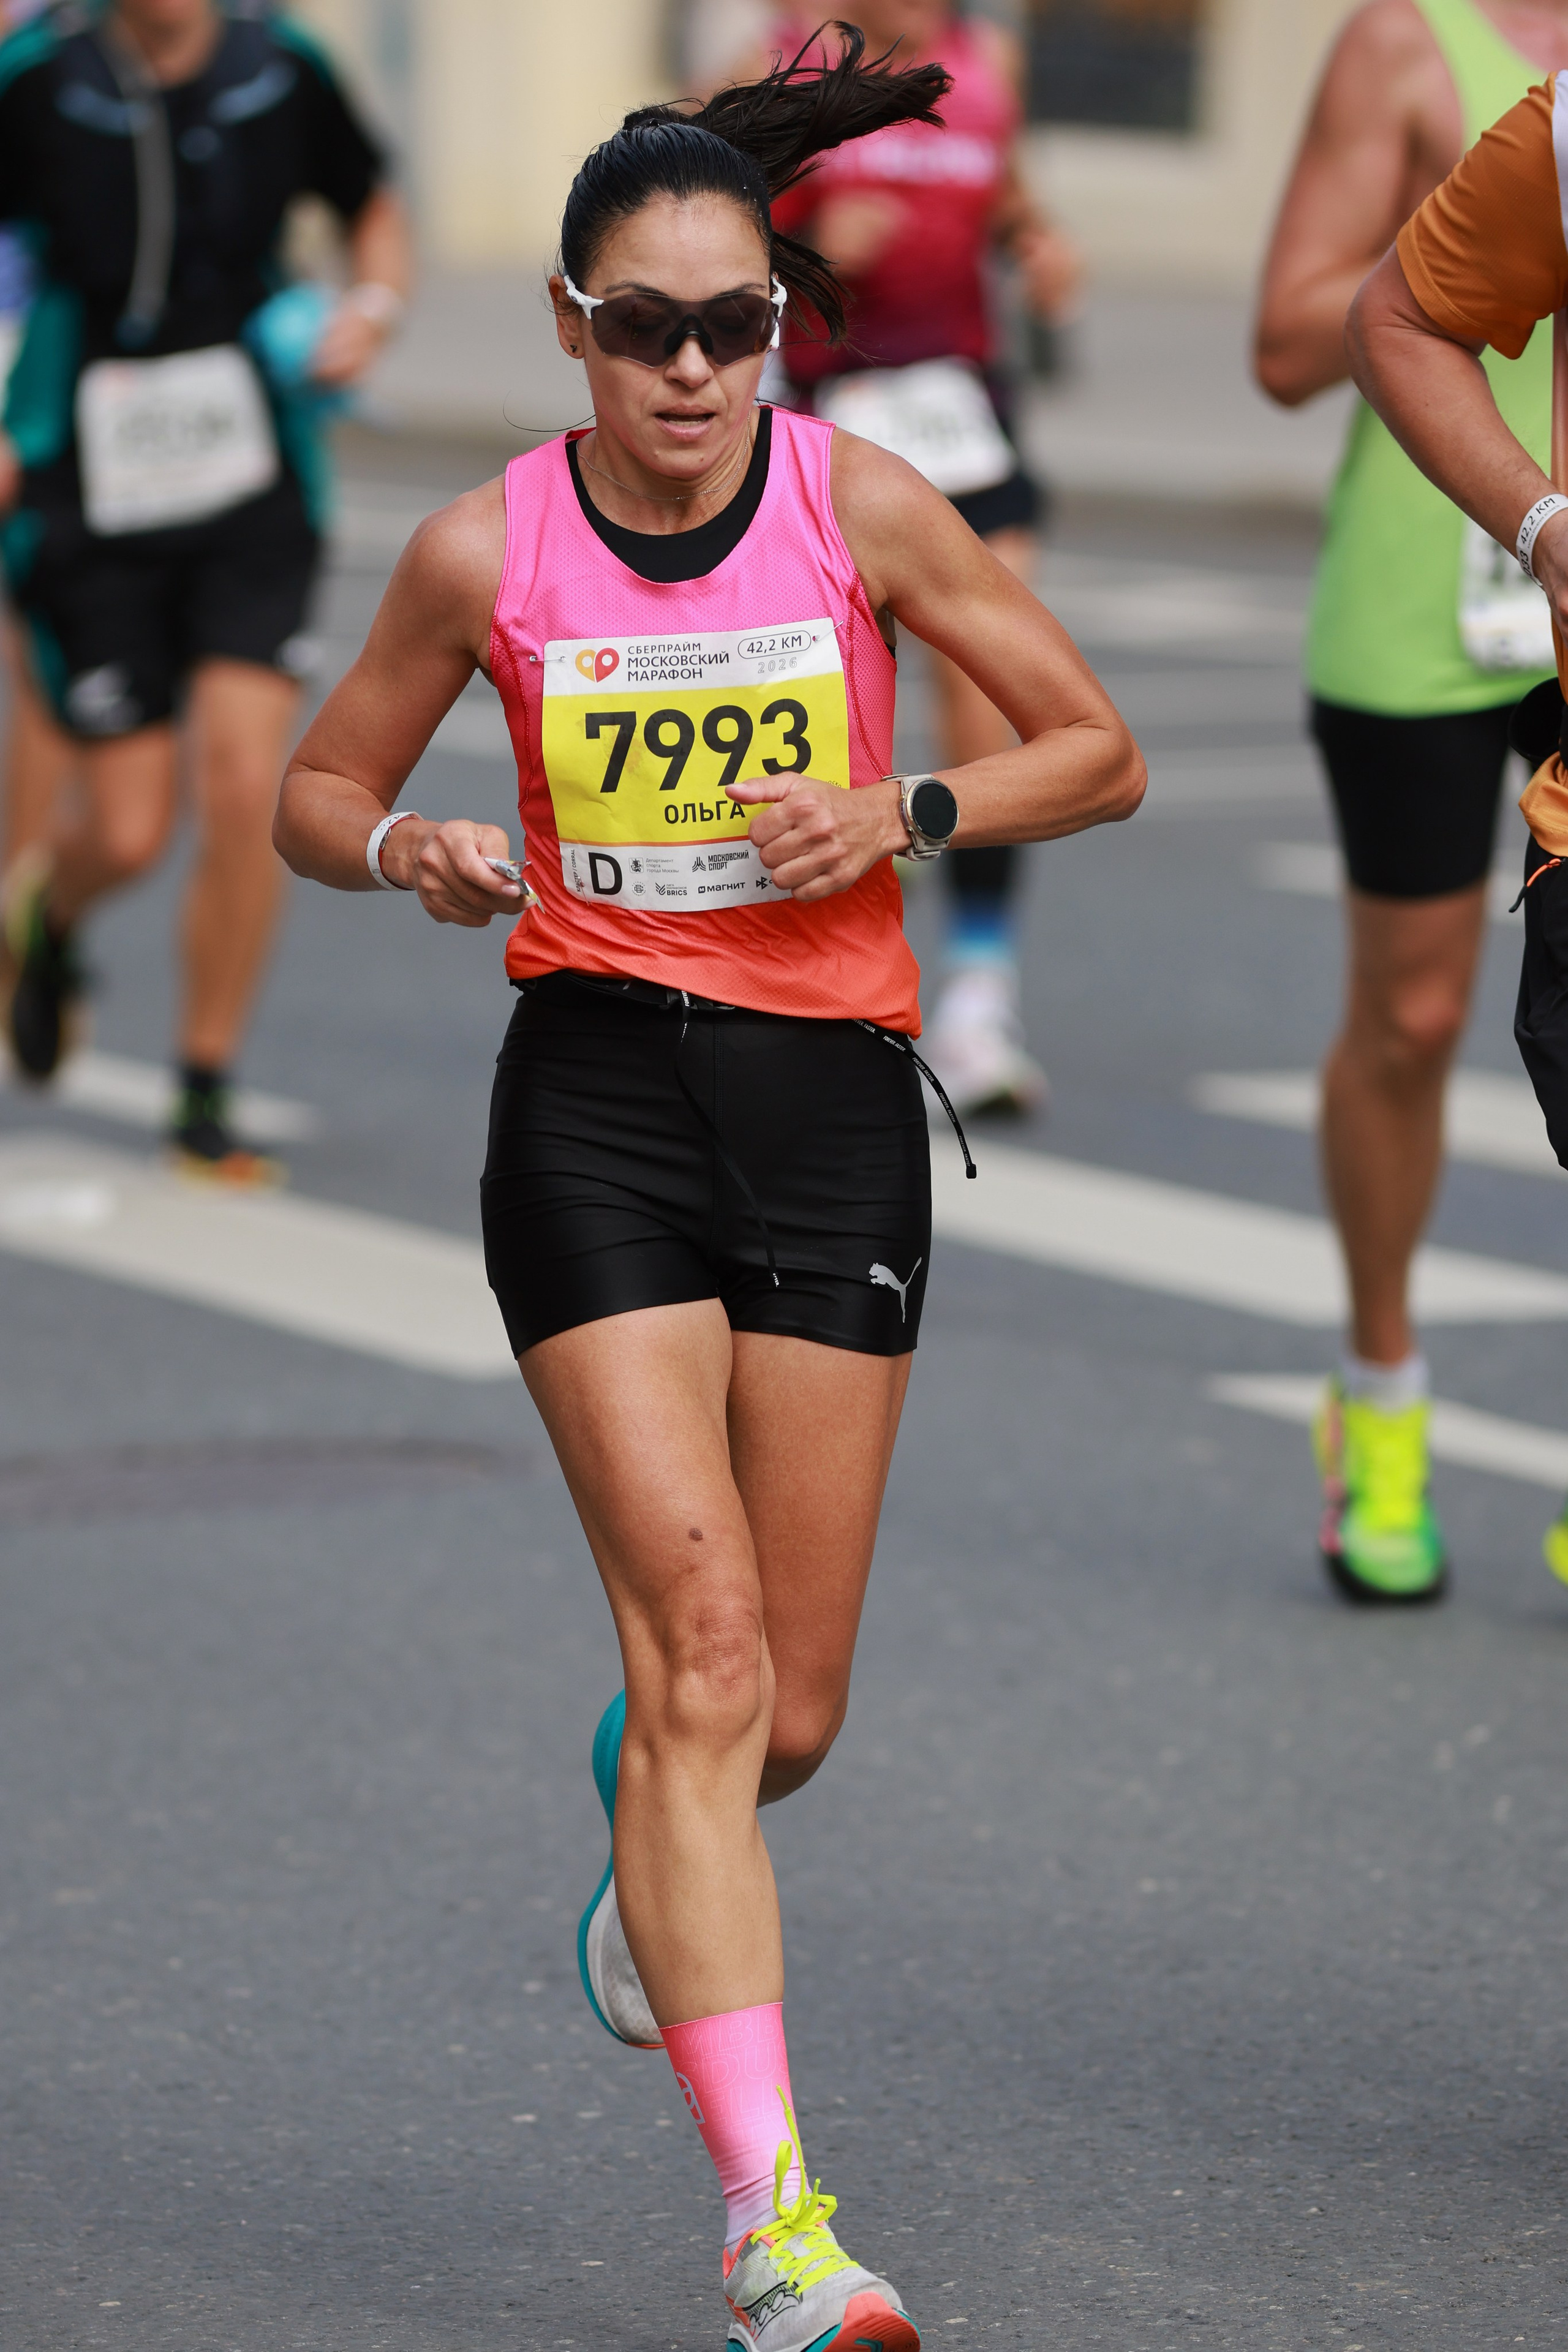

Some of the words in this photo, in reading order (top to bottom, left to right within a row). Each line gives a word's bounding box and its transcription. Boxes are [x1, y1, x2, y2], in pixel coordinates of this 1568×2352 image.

[628, 641, 701, 655] СБЕРПРАЙМ
[747, 639, 776, 654] 42,2
[782, 635, 802, 649] КМ
[628, 650, 729, 668] МОСКОВСКИЙ
[757, 657, 797, 674] 2026
[628, 668, 703, 682] МАРАФОН
[585, 698, 812, 793] 7993
[664, 800, 746, 824] ОЛЬГА
[707, 850, 749, 863] МОСКОВСКИЙ
[588, 852, 623, 895] D
[708, 861, 728, 871] СПОРТ
